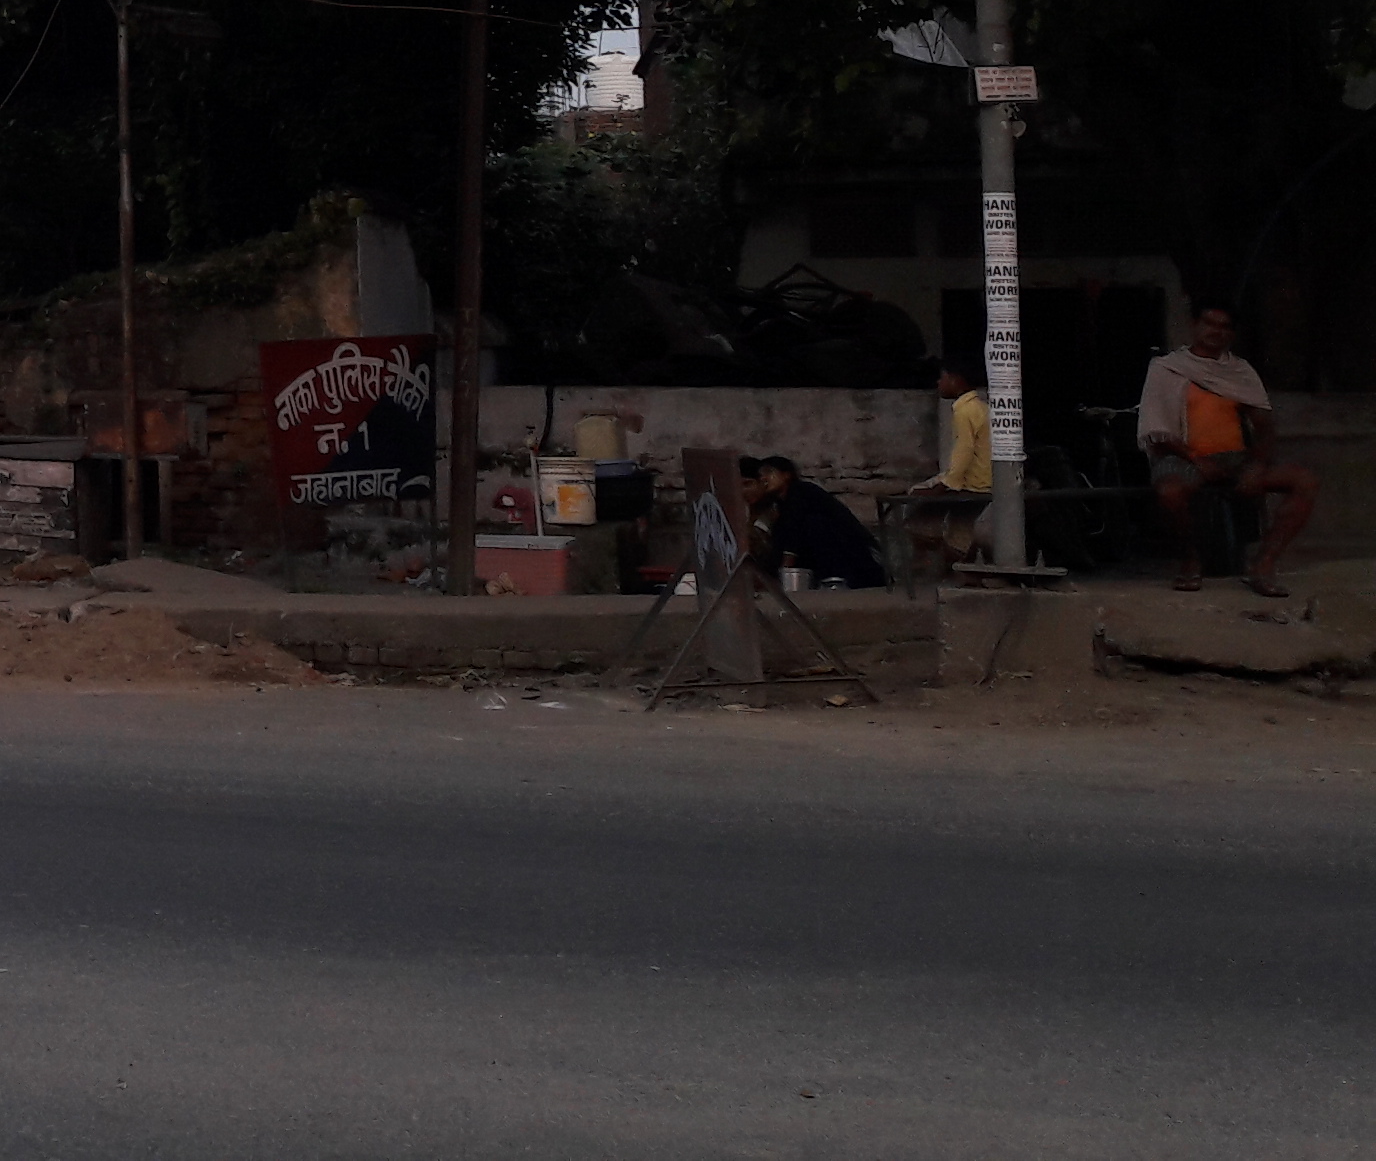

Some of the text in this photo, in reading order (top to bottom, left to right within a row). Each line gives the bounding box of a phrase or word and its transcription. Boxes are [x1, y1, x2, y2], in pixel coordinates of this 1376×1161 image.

[274, 342, 430, 431] नाका पुलिस चौकी
[358, 421, 370, 451] 1
[289, 468, 401, 506] जहानाबाद
